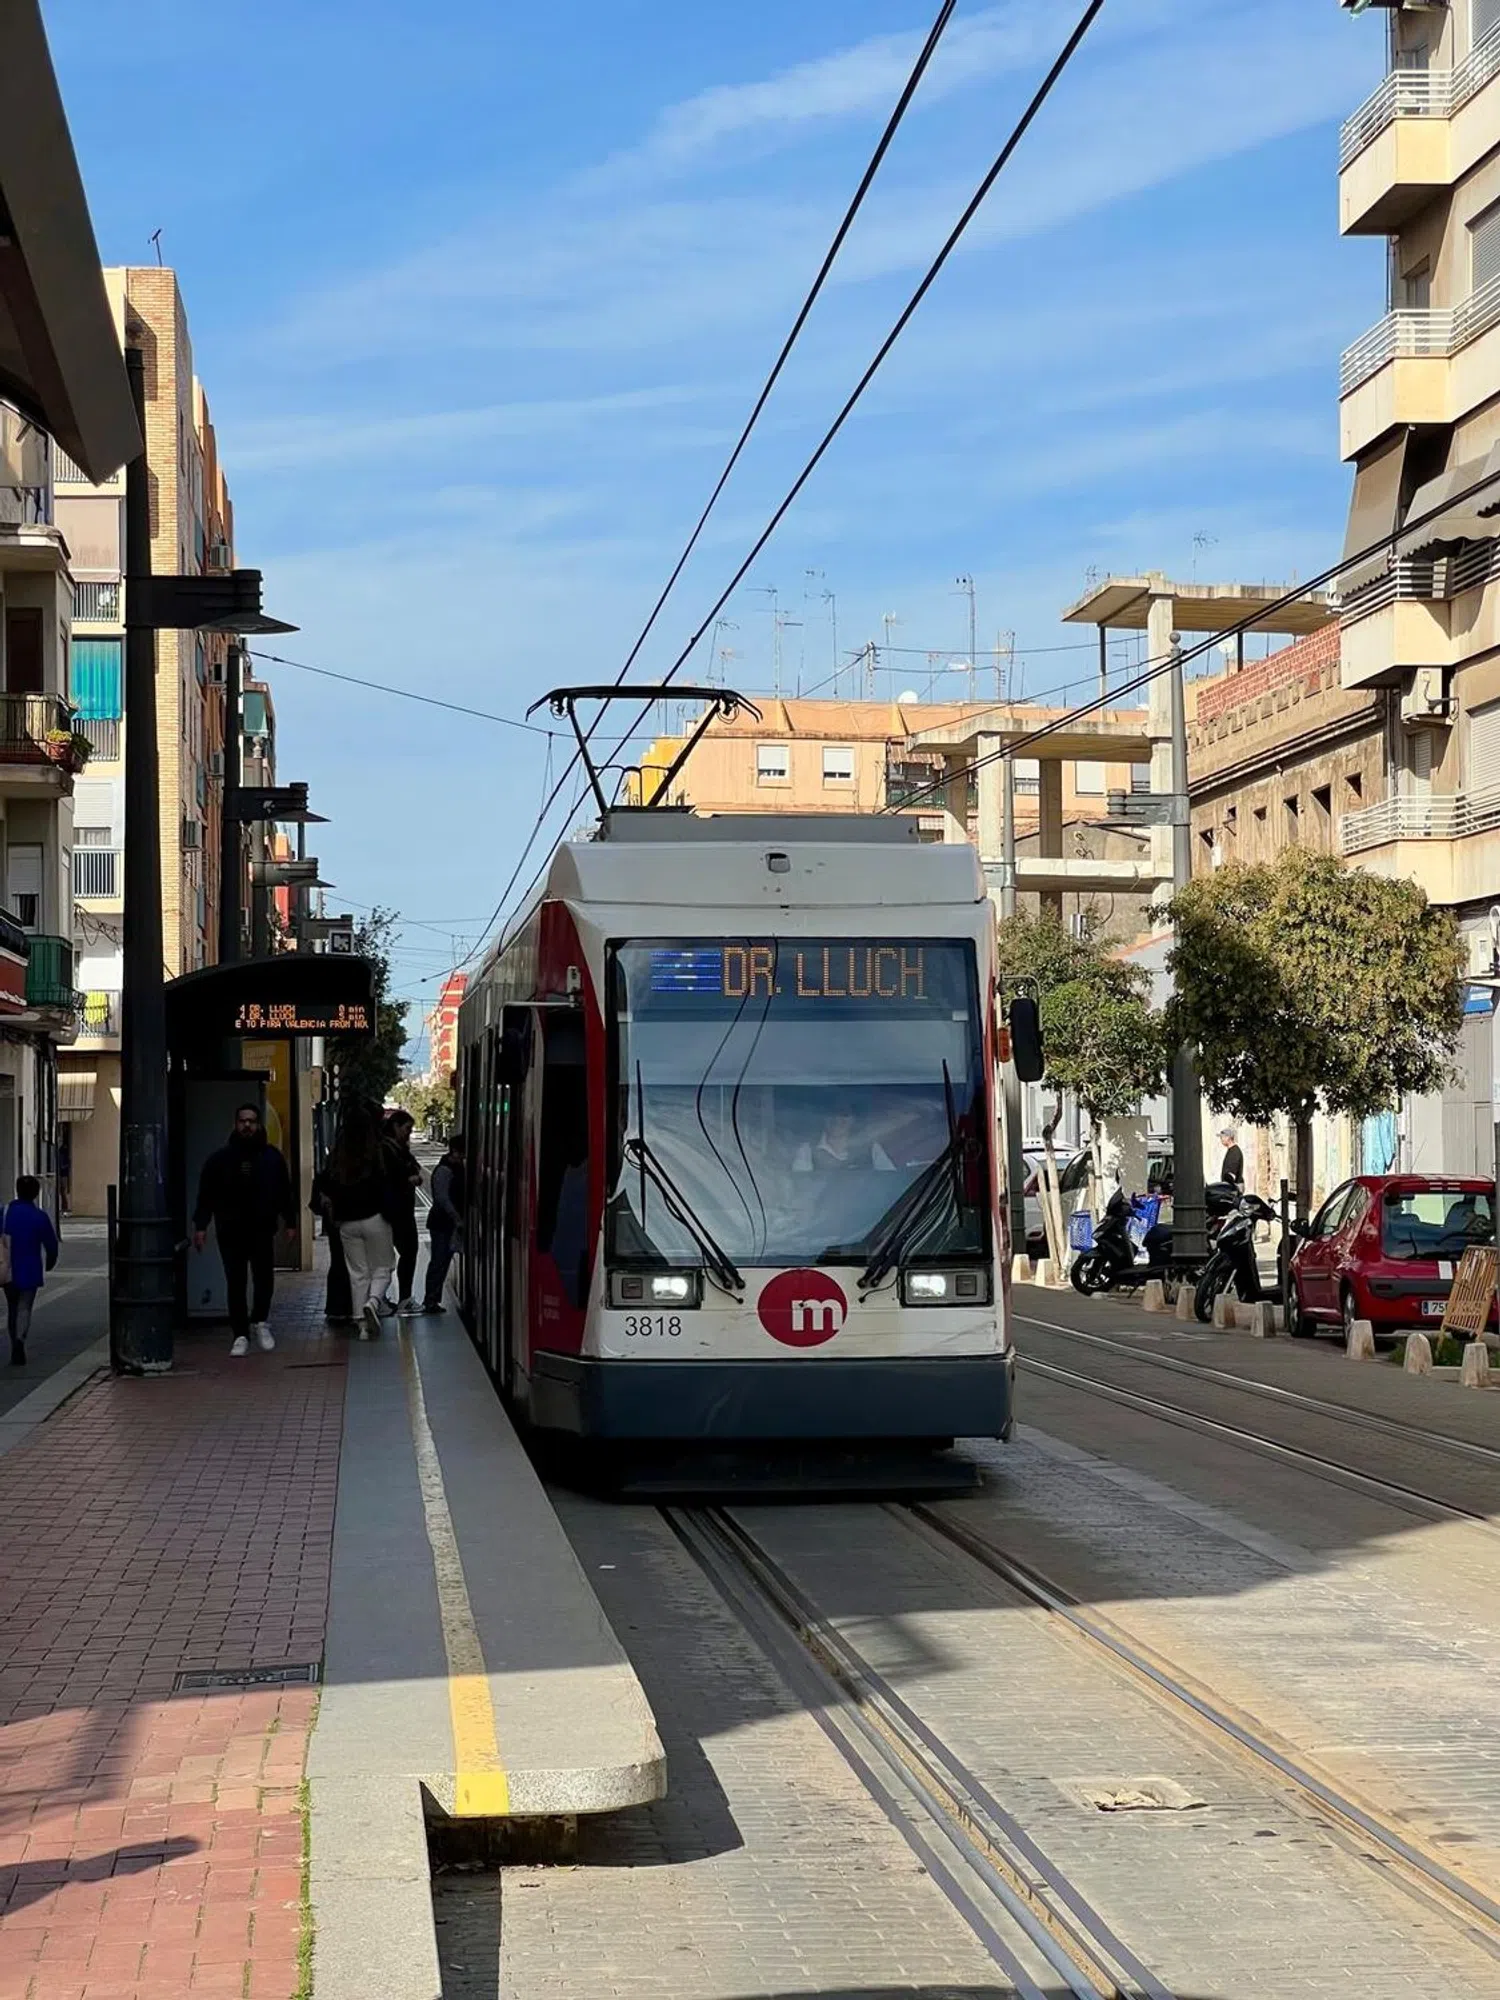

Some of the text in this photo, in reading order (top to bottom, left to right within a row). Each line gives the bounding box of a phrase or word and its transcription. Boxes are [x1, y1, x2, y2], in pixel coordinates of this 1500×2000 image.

[723, 947, 782, 996] DR.
[797, 947, 924, 997] LLUCH
[246, 1020, 257, 1029] TO
[260, 1020, 282, 1029] FIRA
[285, 1020, 327, 1029] VALENCIA
[329, 1020, 352, 1029] FROM
[625, 1315, 682, 1337] 3818
[791, 1298, 844, 1332] m
